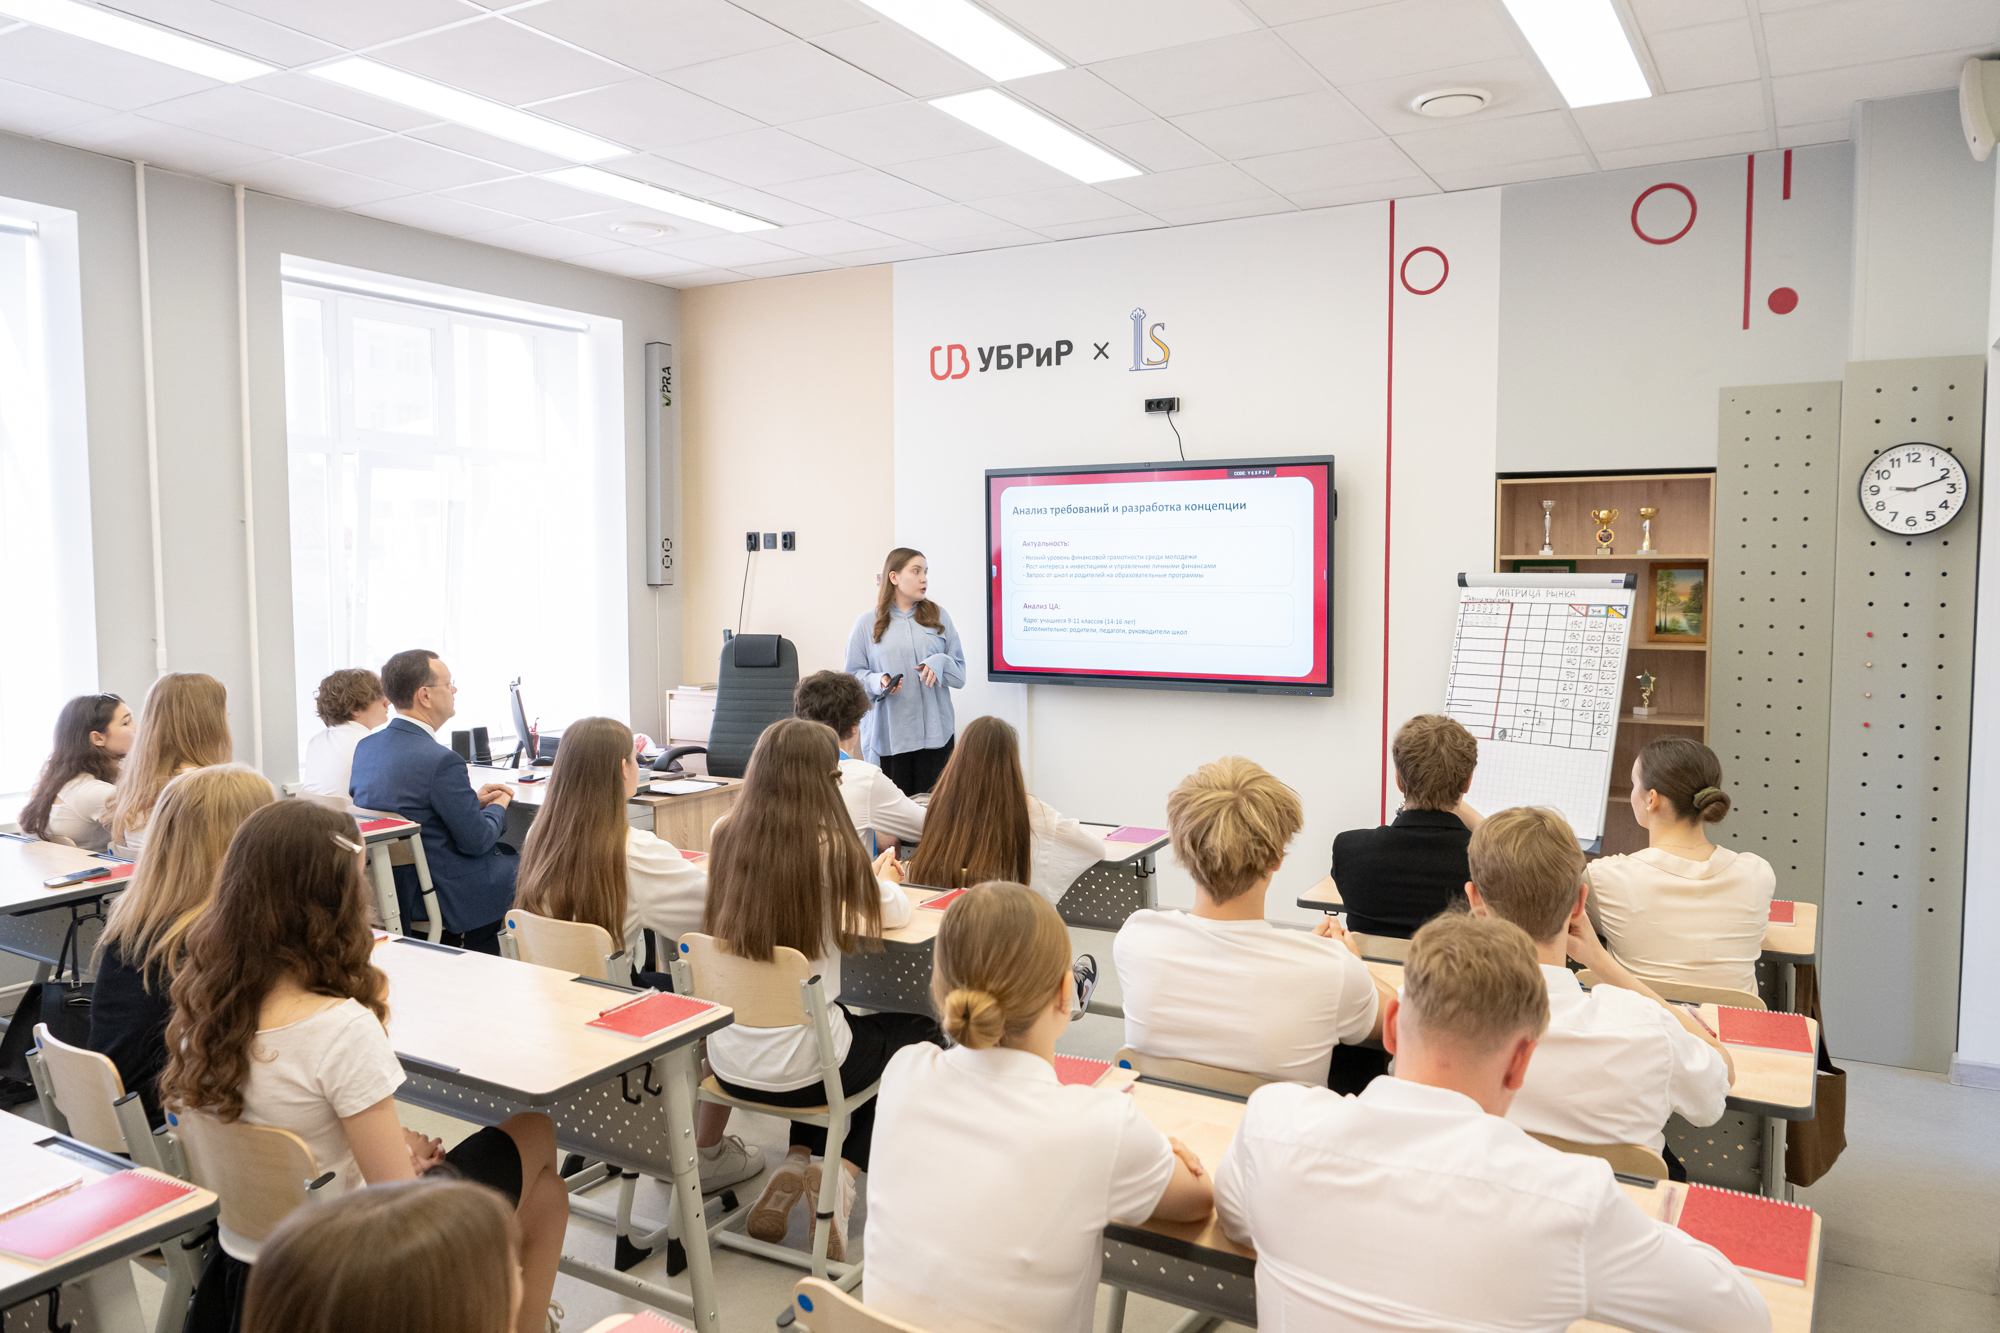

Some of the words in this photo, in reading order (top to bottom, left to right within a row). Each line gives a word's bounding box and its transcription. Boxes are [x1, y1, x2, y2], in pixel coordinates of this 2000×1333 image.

[977, 339, 1074, 372] УБРиР
[1905, 452, 1921, 463] 12
[1929, 457, 1935, 467] 1
[1889, 458, 1901, 468] 11
[1875, 469, 1891, 480] 10
[1940, 468, 1950, 479] 2
[1869, 484, 1881, 496] 9
[1946, 483, 1957, 494] 3
[1012, 506, 1048, 515] Анализ
[1050, 503, 1109, 516] требований
[1112, 505, 1119, 513] и
[1121, 502, 1181, 515] разработка
[1184, 502, 1246, 512] концепции
[1875, 501, 1886, 511] 8
[1938, 499, 1950, 510] 4
[1889, 511, 1899, 522] 7
[1905, 516, 1917, 527] 6
[1925, 511, 1936, 522] 5
[1022, 540, 1070, 548] Актуальность:
[1496, 588, 1541, 599] МАТРИЦА
[1546, 589, 1576, 598] РЫНКА
[1049, 603, 1061, 611] ЦА:
[1590, 620, 1604, 629] 220
[1586, 634, 1601, 642] 200
[1566, 645, 1578, 654] 100
[1605, 646, 1620, 655] 300
[1602, 660, 1618, 669] 250
[1601, 672, 1617, 680] 200
[1562, 683, 1574, 691] 20
[1560, 698, 1570, 707] 10
[1581, 699, 1593, 708] 20
[1596, 700, 1610, 710] 100
[1580, 712, 1590, 720] 10
[1598, 713, 1610, 725] 50
[1596, 726, 1609, 736] 20
